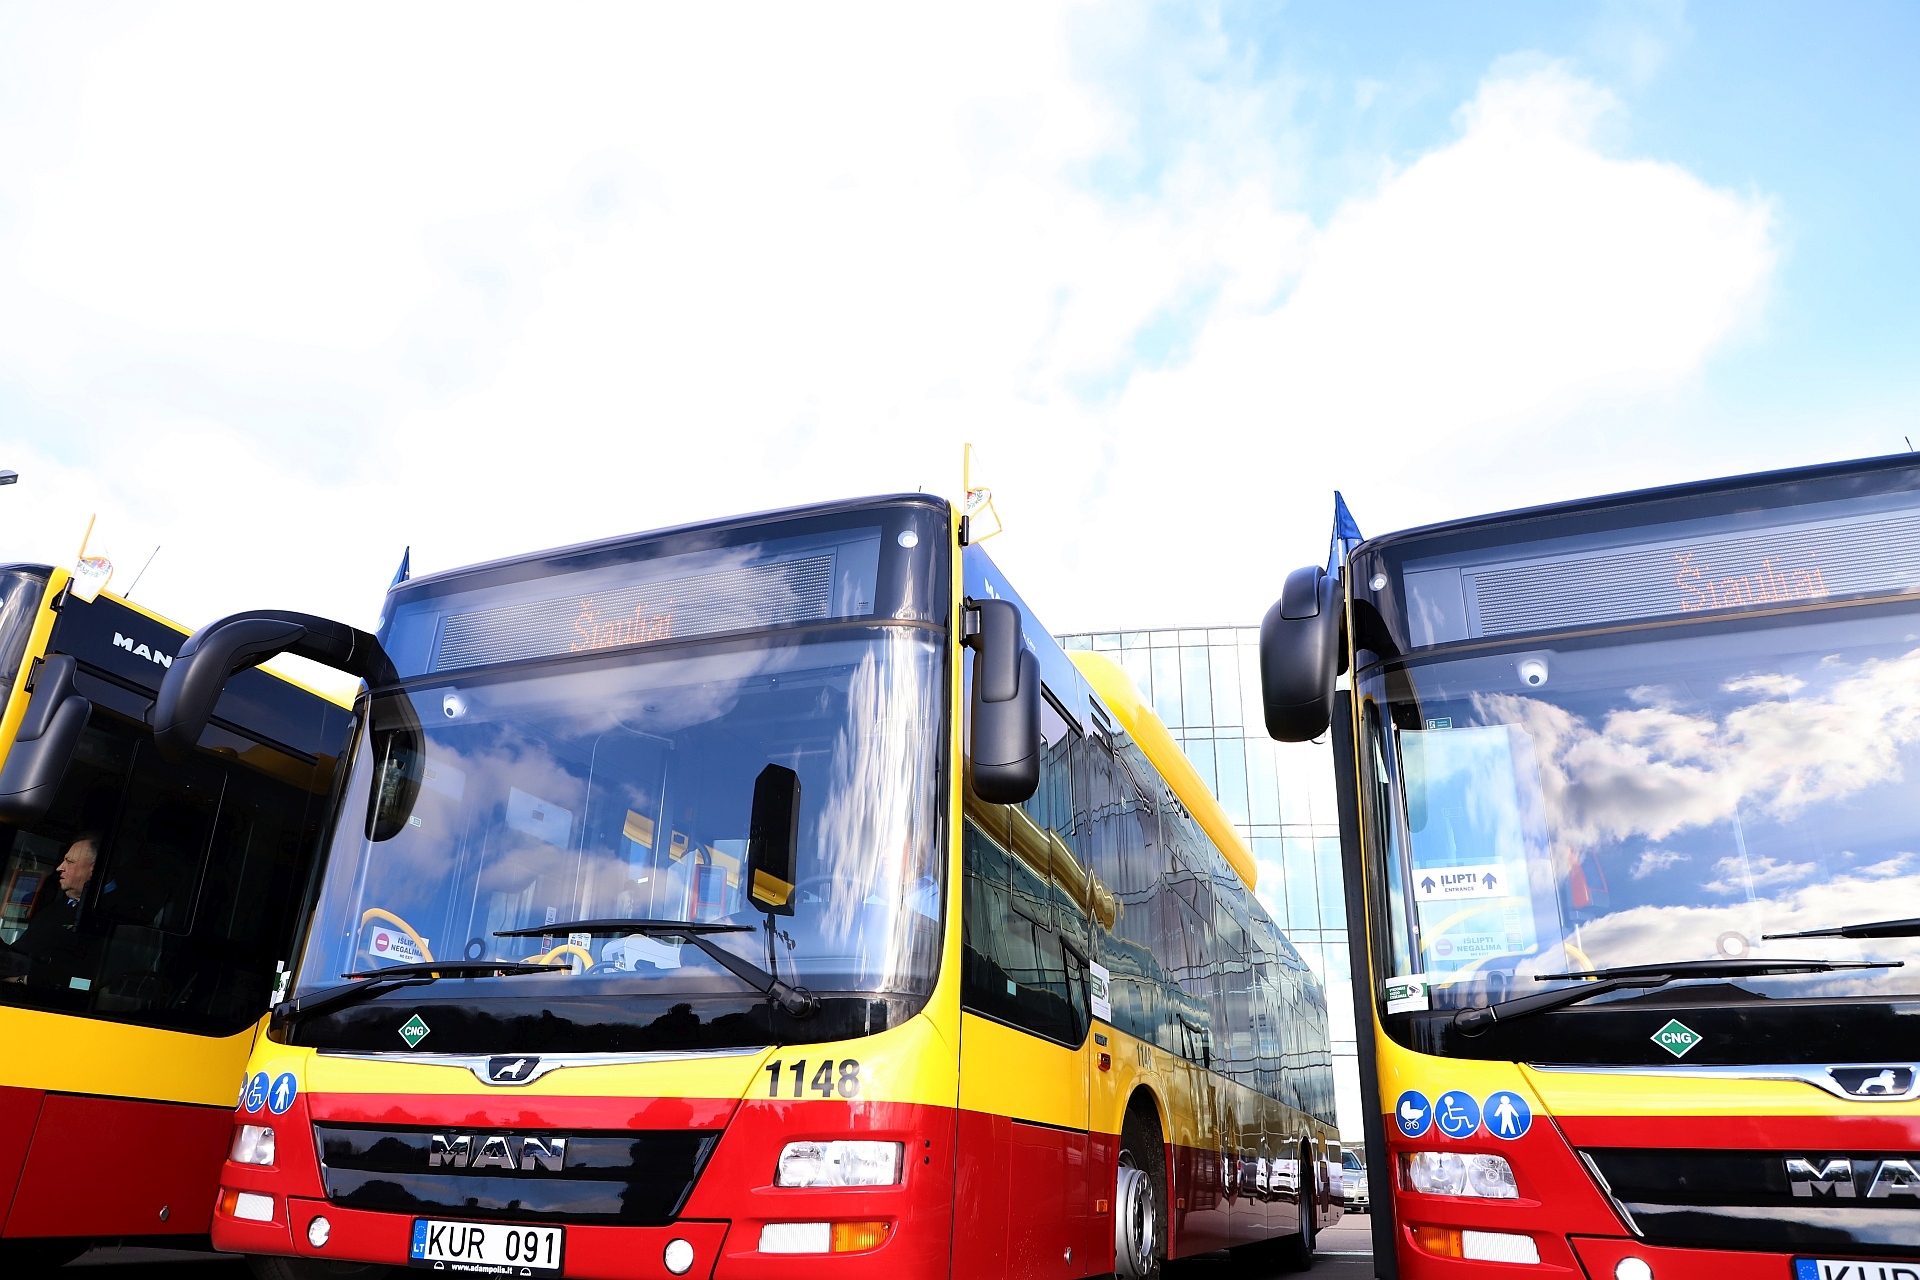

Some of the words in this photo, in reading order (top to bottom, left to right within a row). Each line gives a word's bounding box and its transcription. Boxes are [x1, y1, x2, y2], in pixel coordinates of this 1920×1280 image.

[1673, 551, 1830, 611] Šiauliai
[570, 597, 673, 650] Šiauliai
[112, 631, 173, 669] MAN
[1440, 873, 1477, 887] ĮLIPTI
[1456, 944, 1502, 952] NEGALIMA
[1463, 936, 1494, 944] IŠLIPTI
[404, 1026, 424, 1036] CNG
[1661, 1032, 1692, 1044] CNG
[1136, 1042, 1152, 1070] 1148
[765, 1058, 860, 1099] 1148
[428, 1135, 567, 1172] MAN
[413, 1243, 425, 1253] LT
[428, 1224, 485, 1259] KUR
[505, 1230, 554, 1264] 091
[451, 1263, 513, 1275] www.adampolis.lt
